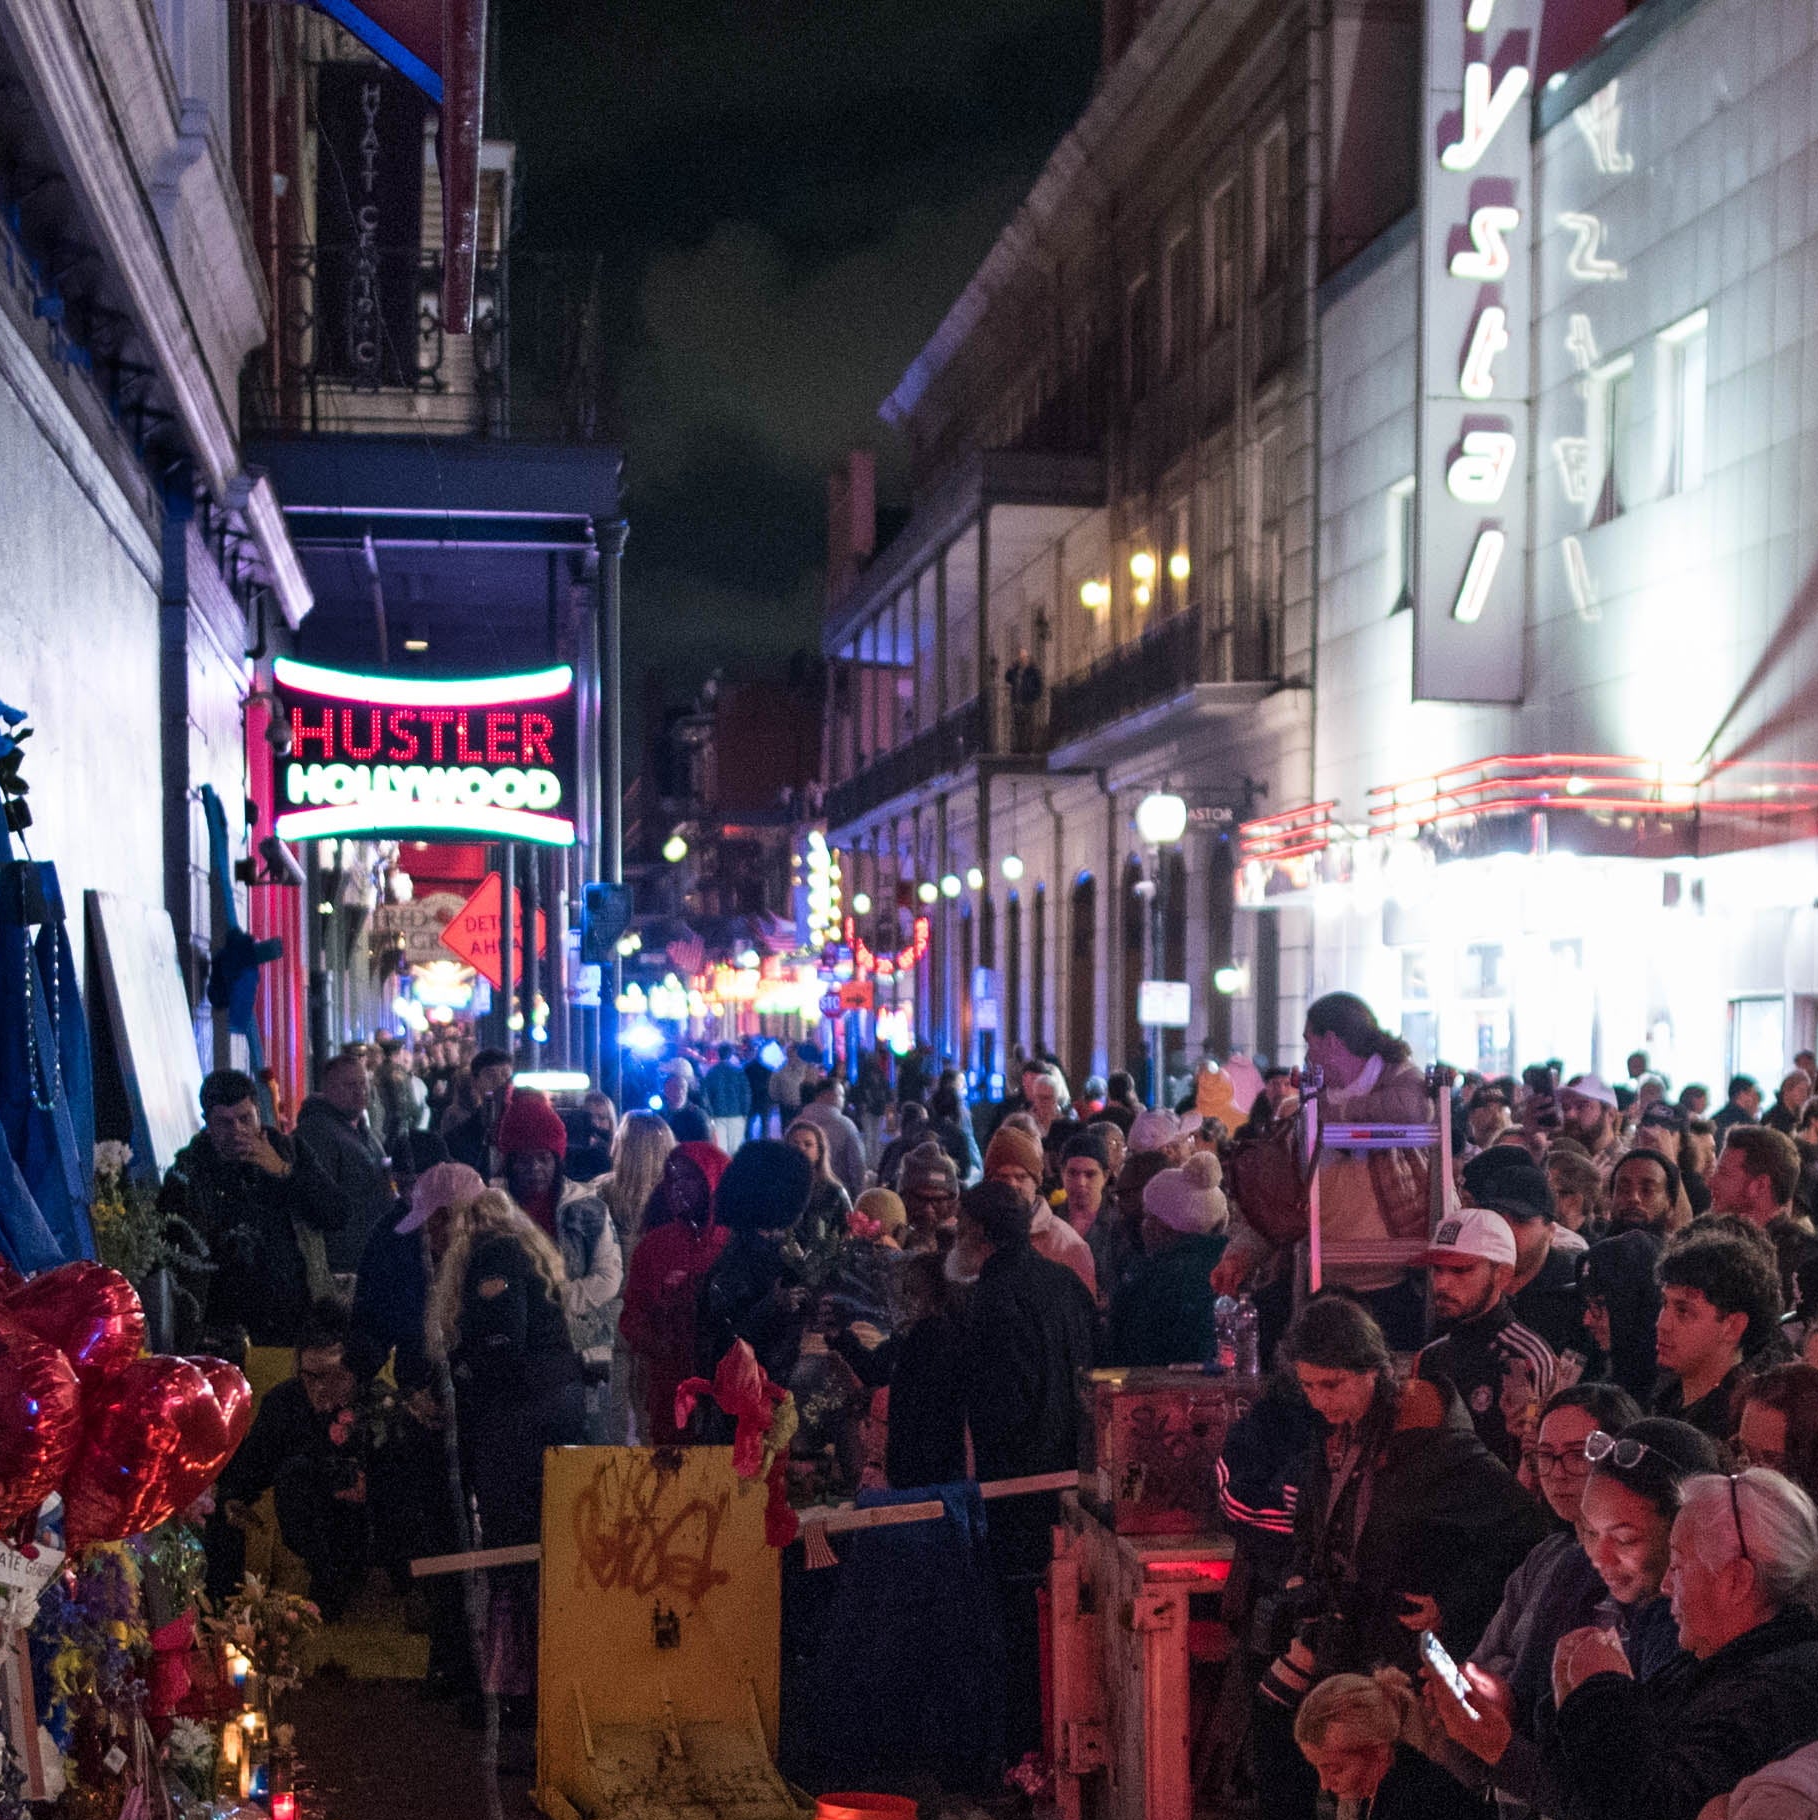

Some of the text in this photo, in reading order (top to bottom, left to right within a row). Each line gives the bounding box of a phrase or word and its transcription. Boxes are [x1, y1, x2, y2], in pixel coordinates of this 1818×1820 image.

[291, 706, 555, 764] HUSTLER
[287, 762, 562, 809] HOLLYWOOD
[821, 992, 841, 1007] STO
